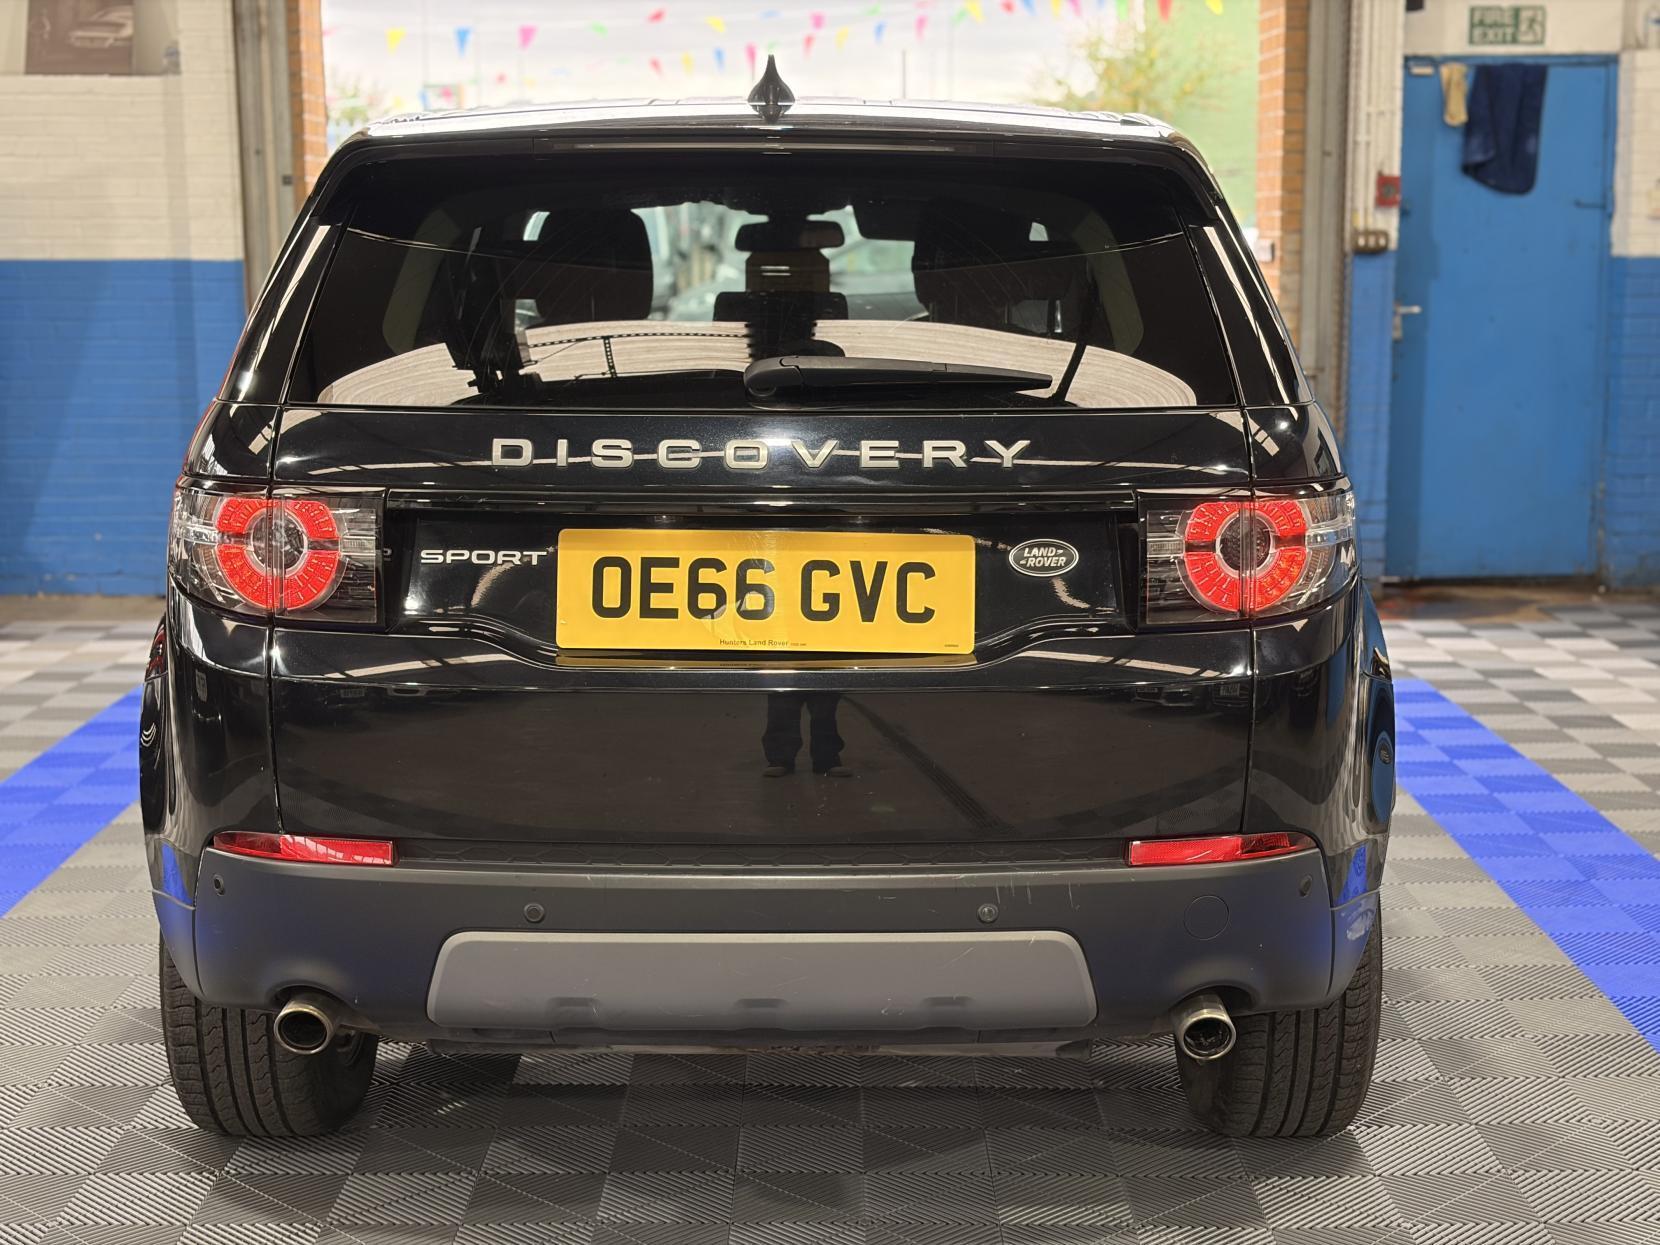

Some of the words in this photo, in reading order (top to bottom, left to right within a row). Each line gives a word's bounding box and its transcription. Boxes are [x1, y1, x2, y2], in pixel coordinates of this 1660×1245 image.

[491, 437, 1031, 469] DISCOVERY
[420, 549, 548, 566] SPORT
[1023, 547, 1057, 557] LAND
[1026, 557, 1067, 567] ROVER
[591, 555, 776, 621] OE66
[799, 559, 937, 625] GVC
[719, 638, 747, 647] Hunters
[748, 639, 767, 647] Land
[767, 639, 789, 648] Rover
